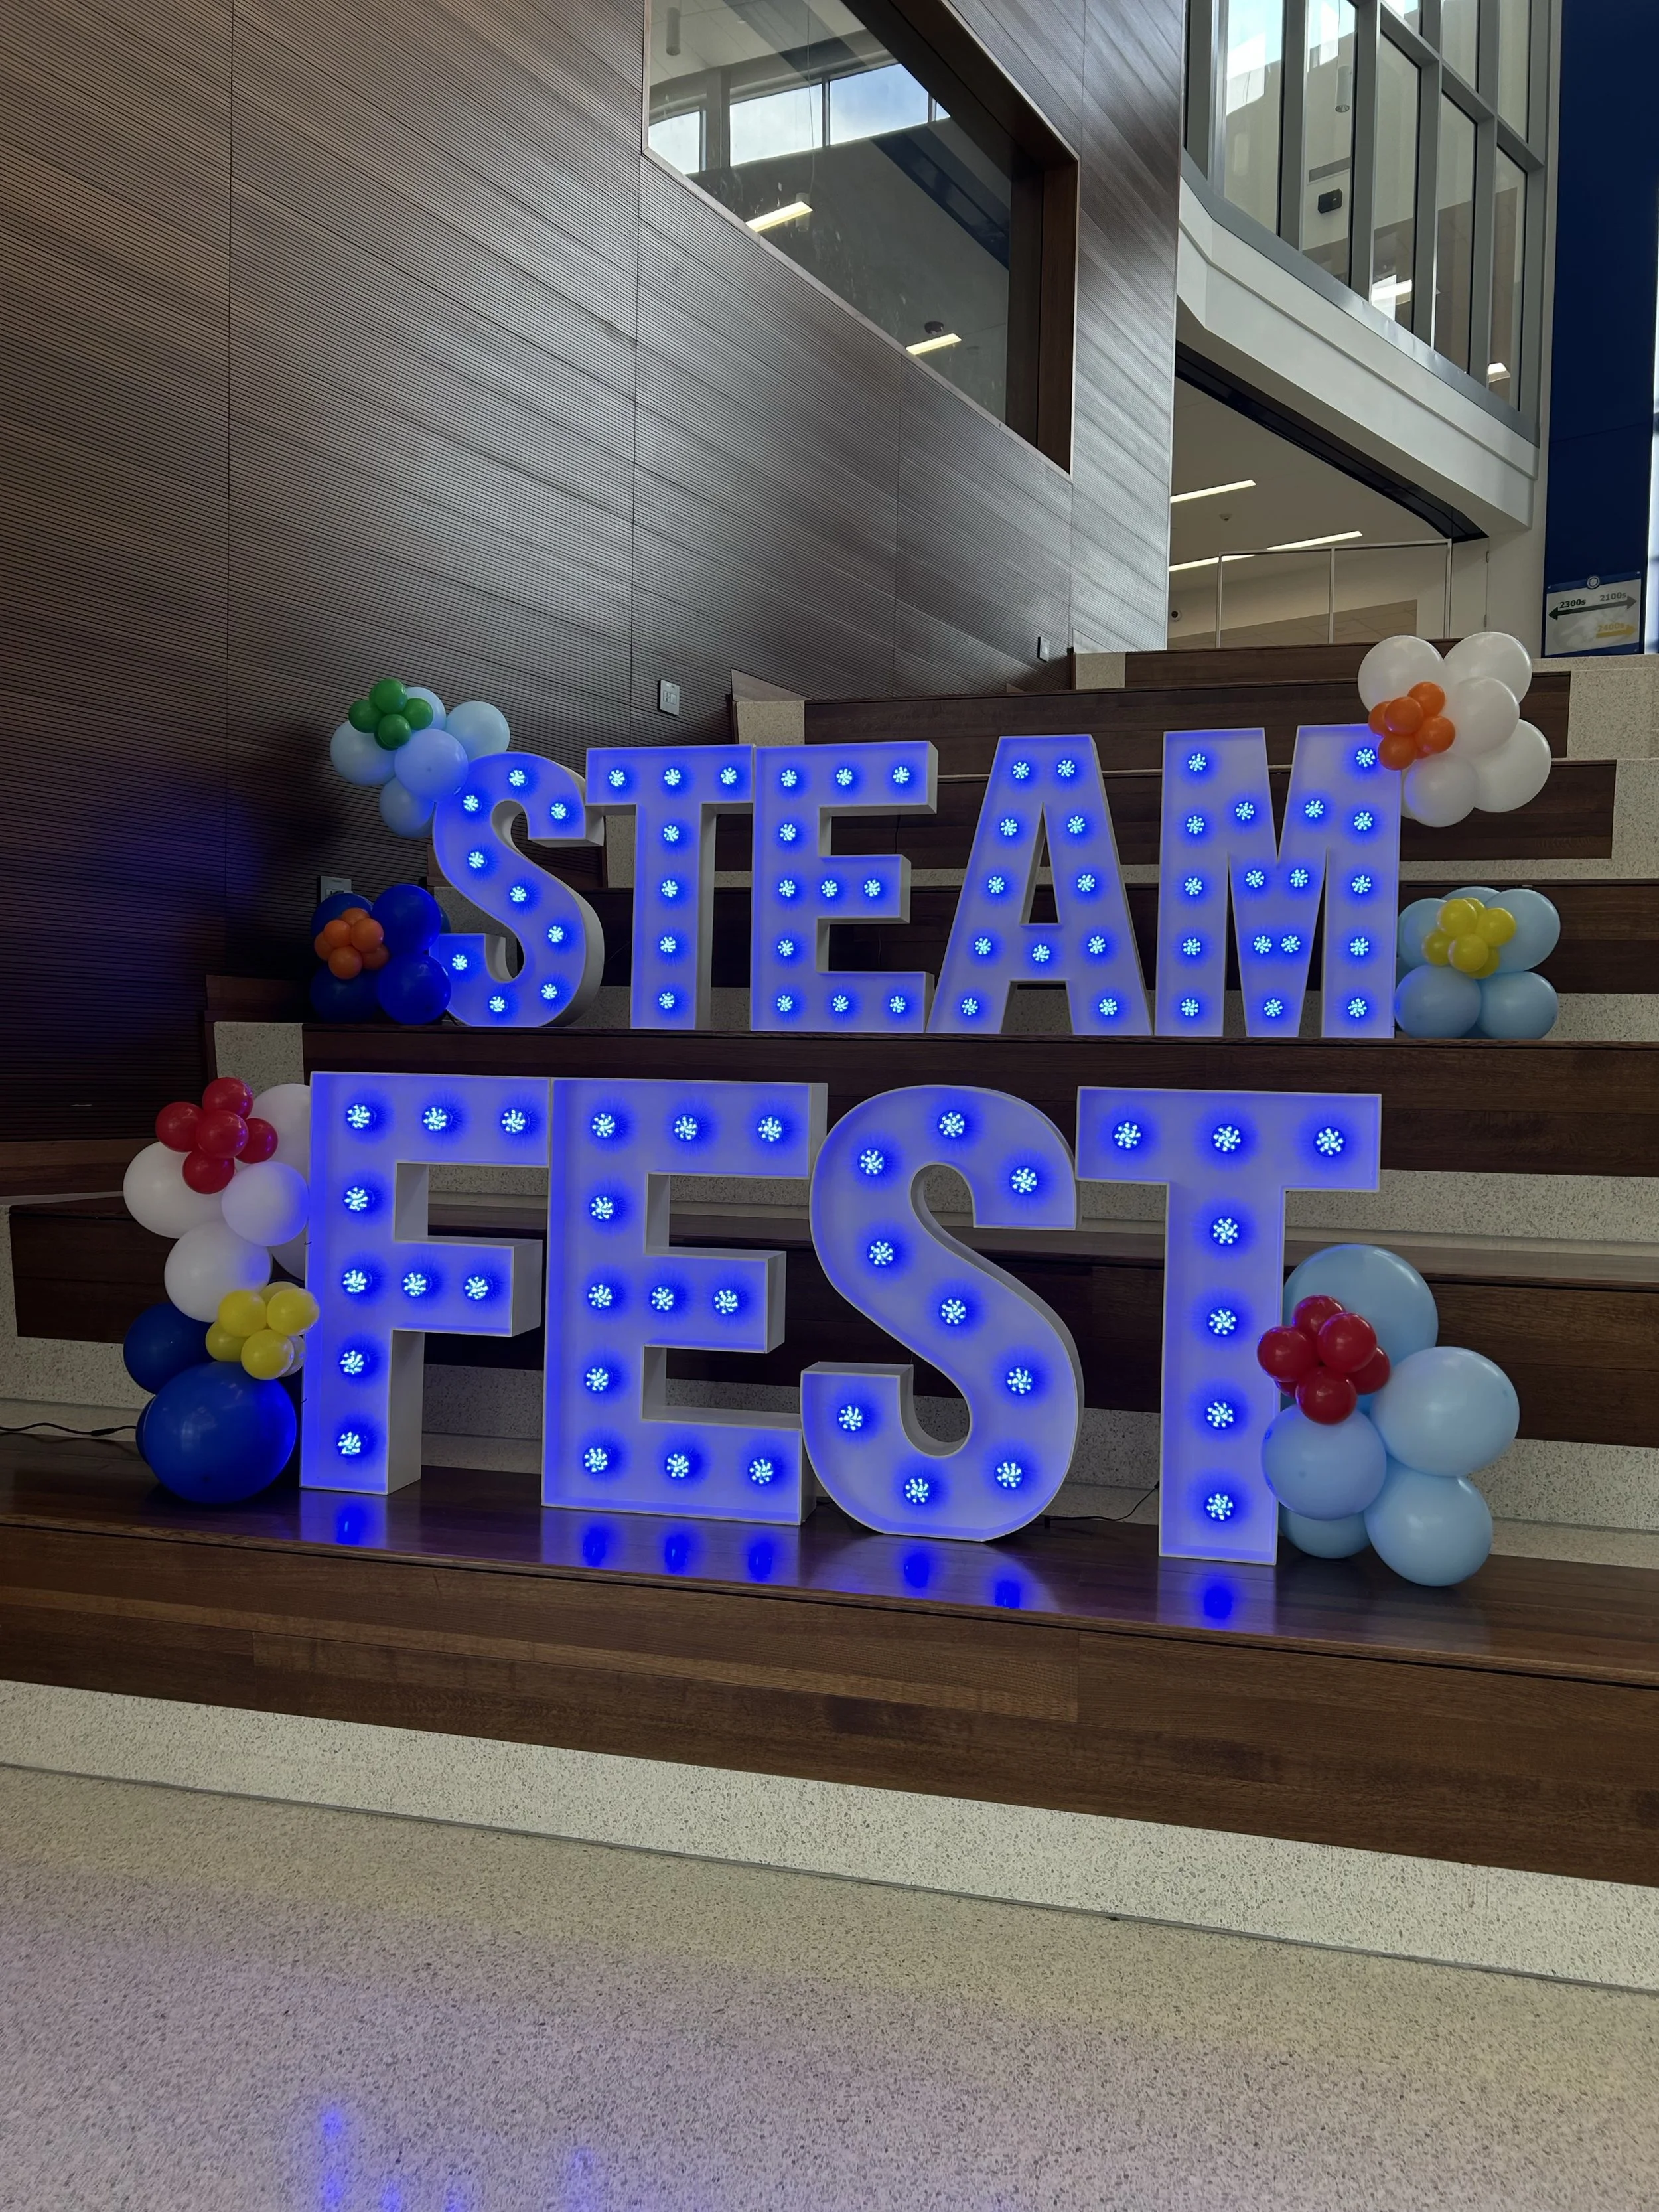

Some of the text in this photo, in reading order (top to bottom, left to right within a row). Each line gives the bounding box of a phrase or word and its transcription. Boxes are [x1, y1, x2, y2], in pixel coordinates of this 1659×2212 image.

[1560, 599, 1586, 609] 2300s
[1599, 592, 1626, 601] 2100s
[433, 724, 1401, 1037] STEAM
[299, 1071, 1381, 1565] FEST
